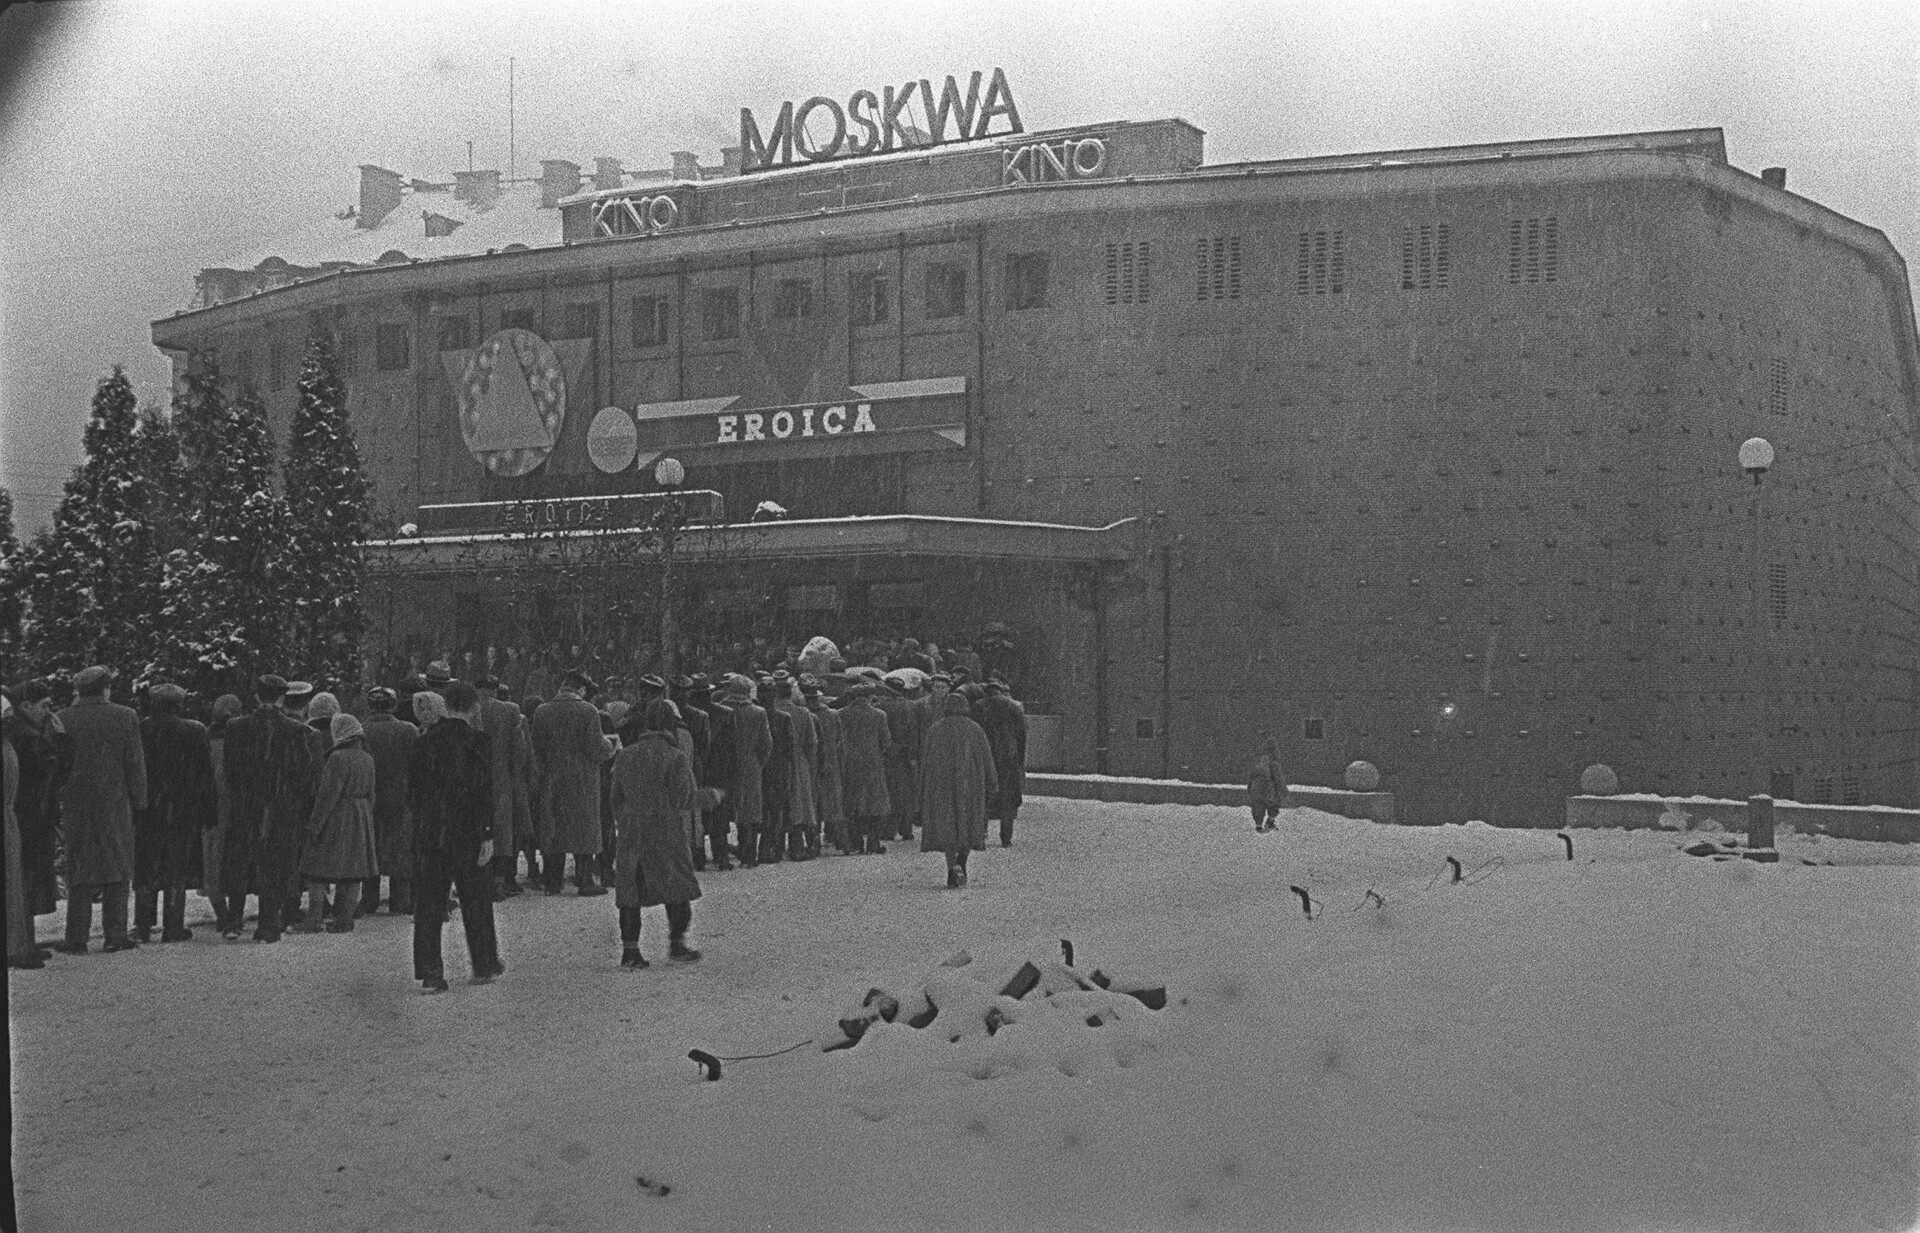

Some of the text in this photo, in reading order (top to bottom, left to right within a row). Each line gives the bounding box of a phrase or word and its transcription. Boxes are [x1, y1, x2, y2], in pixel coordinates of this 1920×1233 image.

[741, 67, 1024, 168] MOSKWA
[1003, 138, 1105, 185] KINO
[591, 195, 678, 237] KINO
[718, 404, 876, 443] EROICA
